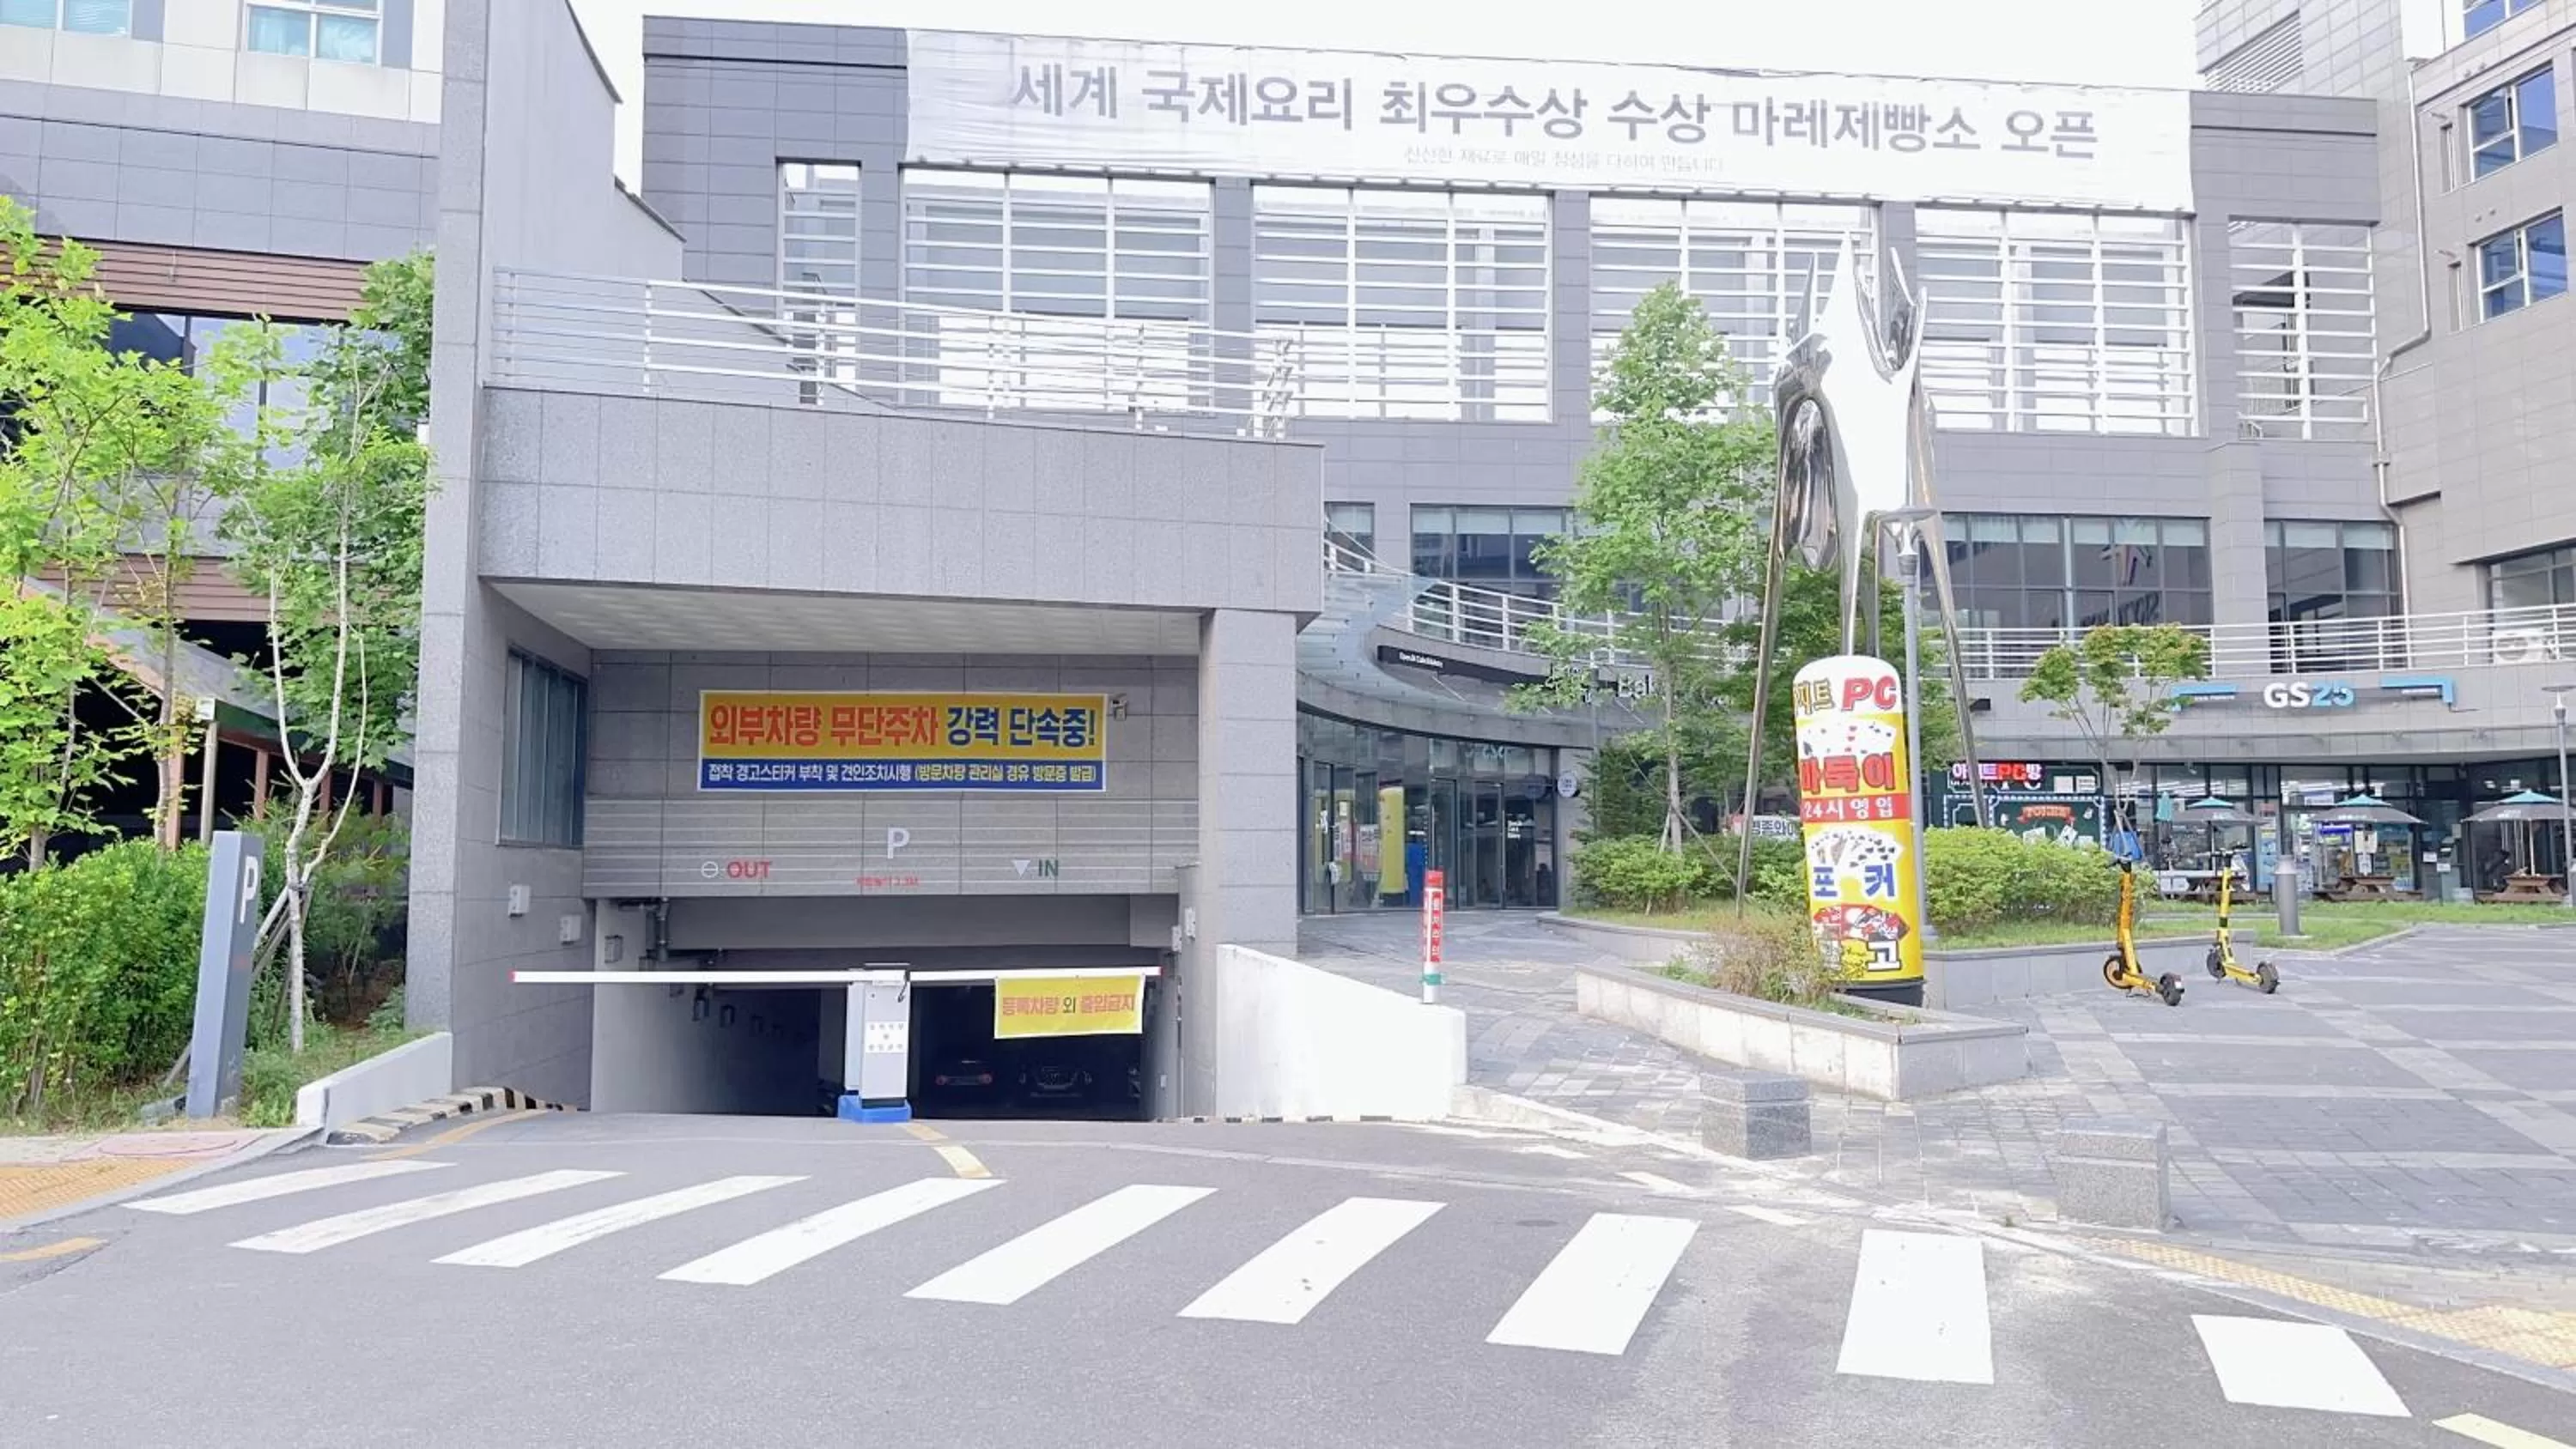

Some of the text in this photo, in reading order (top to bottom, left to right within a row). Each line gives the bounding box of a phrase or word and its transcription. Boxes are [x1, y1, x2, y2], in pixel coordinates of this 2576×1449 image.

[1013, 64, 2098, 159] 세계 국제요리 최우수상 수상 마레제빵소 오픈
[1841, 676, 1897, 712] PC
[2263, 679, 2355, 709] GS25
[710, 705, 1096, 748] 외부차량 무단주차 강력 단속중!
[708, 763, 732, 782] 접착
[736, 763, 796, 782] 경고스티커
[799, 763, 823, 782] 부착
[826, 764, 838, 781] 및
[841, 763, 911, 782] 견인조치시행
[1952, 762, 2043, 781] 아트PC방
[887, 827, 909, 859] P
[726, 861, 771, 879] OUT
[1038, 859, 1060, 876] IN
[240, 856, 258, 925] P
[1002, 994, 1135, 1016] 등록차량 외 출입금지
